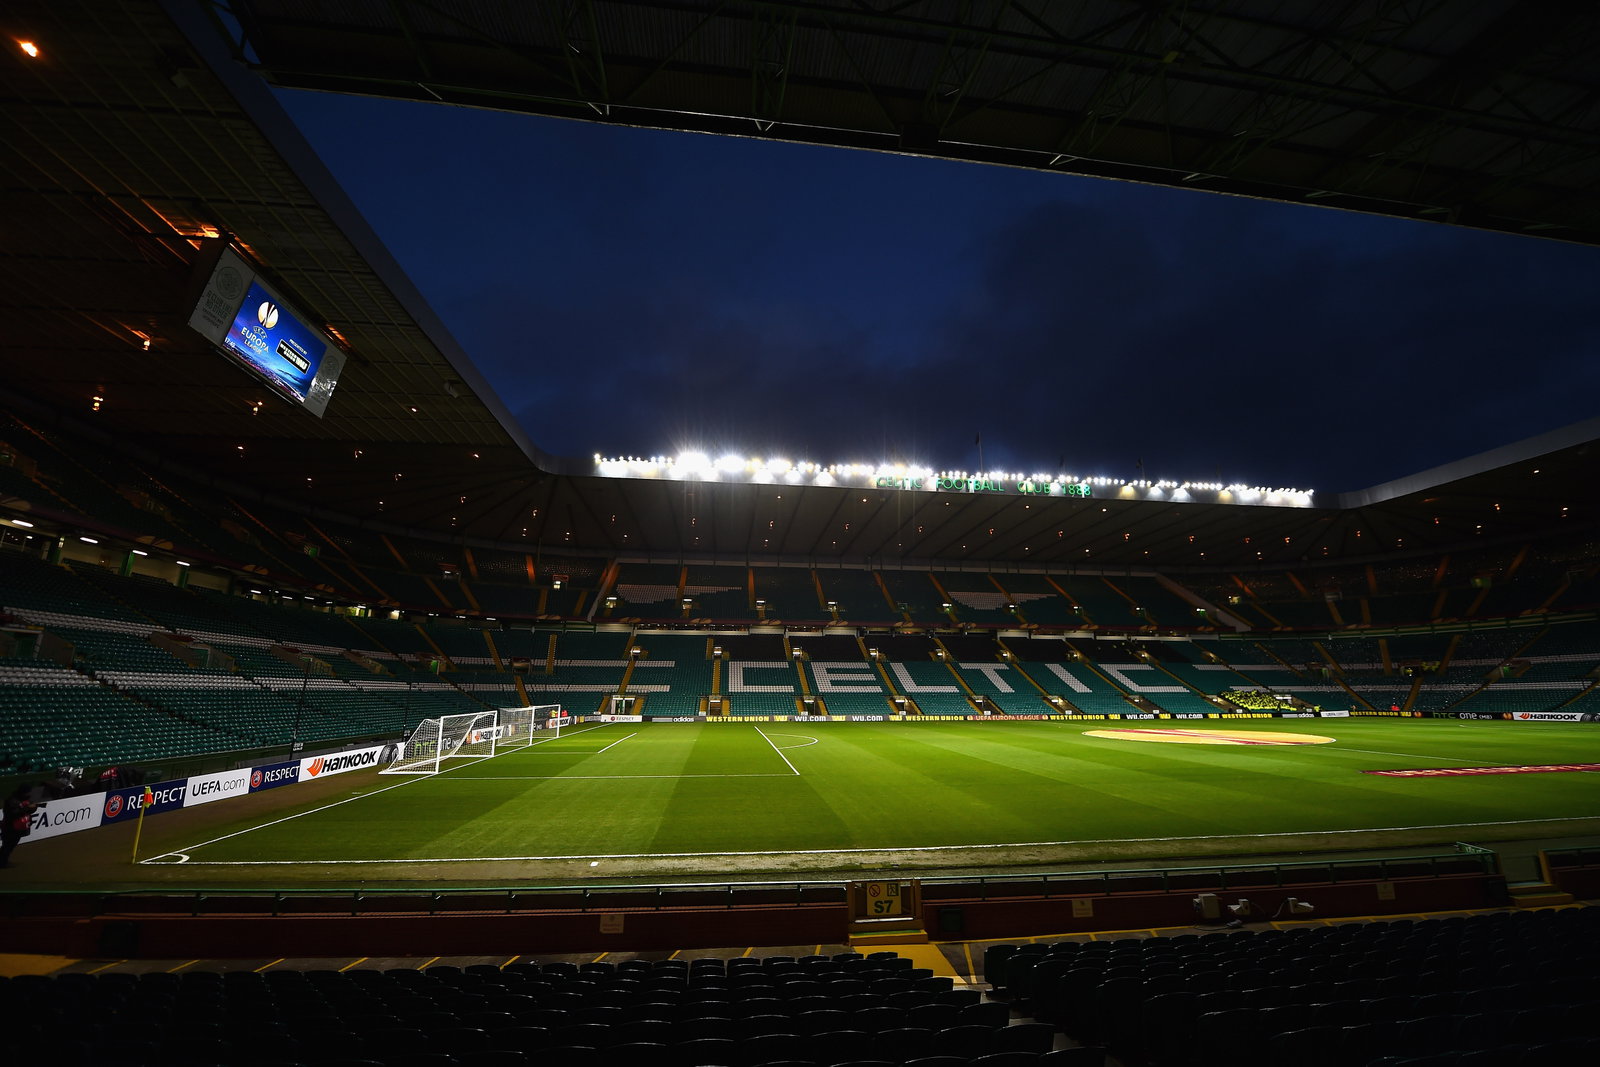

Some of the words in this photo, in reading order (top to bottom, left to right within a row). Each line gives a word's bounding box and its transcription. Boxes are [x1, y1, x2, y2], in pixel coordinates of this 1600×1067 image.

[241, 326, 269, 352] EUROPA
[244, 339, 263, 355] LEAGUE
[876, 476, 923, 489] CELTIC
[936, 477, 1005, 492] FOOTBALL
[1017, 481, 1051, 494] CLUB
[1062, 483, 1092, 496] 1888
[729, 661, 1190, 693] CELTIC
[321, 750, 377, 774] HANKOOK
[264, 765, 300, 783] RESPECT
[192, 777, 246, 797] UEFA.com
[126, 786, 186, 811] REPECT
[30, 807, 91, 830] FA.com
[874, 900, 893, 914] S7
